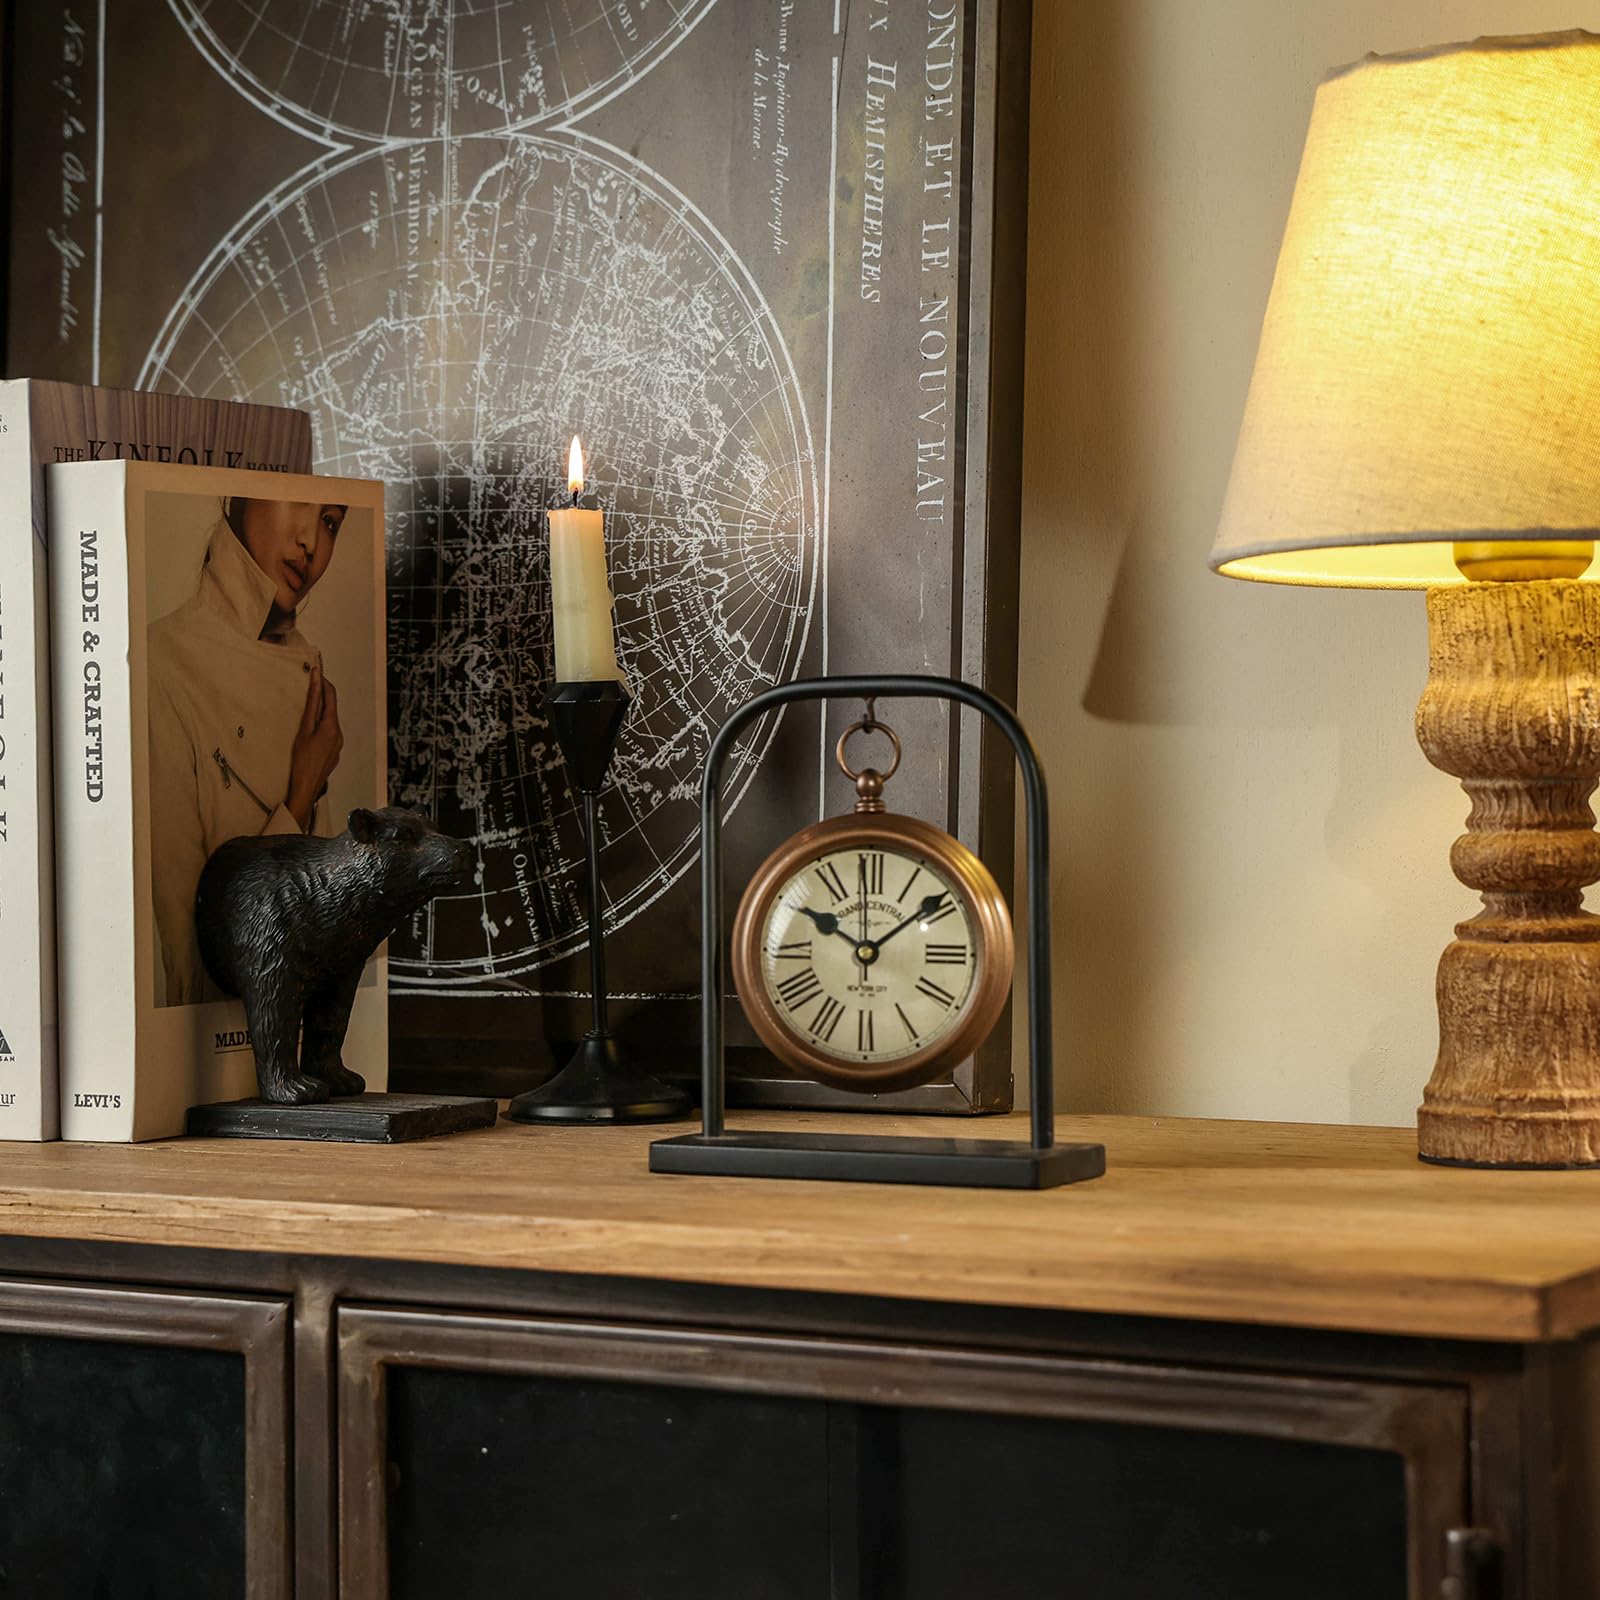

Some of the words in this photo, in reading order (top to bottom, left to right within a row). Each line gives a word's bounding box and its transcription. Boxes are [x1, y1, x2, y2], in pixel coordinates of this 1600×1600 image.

[753, 48, 770, 67] de
[753, 72, 769, 87] la
[923, 137, 954, 198] ET
[920, 217, 951, 273] LE
[915, 296, 948, 525] NOUVEAU
[54, 446, 83, 464] THE
[81, 529, 100, 623] MADE
[82, 630, 100, 654] &
[83, 660, 104, 804] CRAFTED
[74, 1094, 121, 1108] LEVI'S
